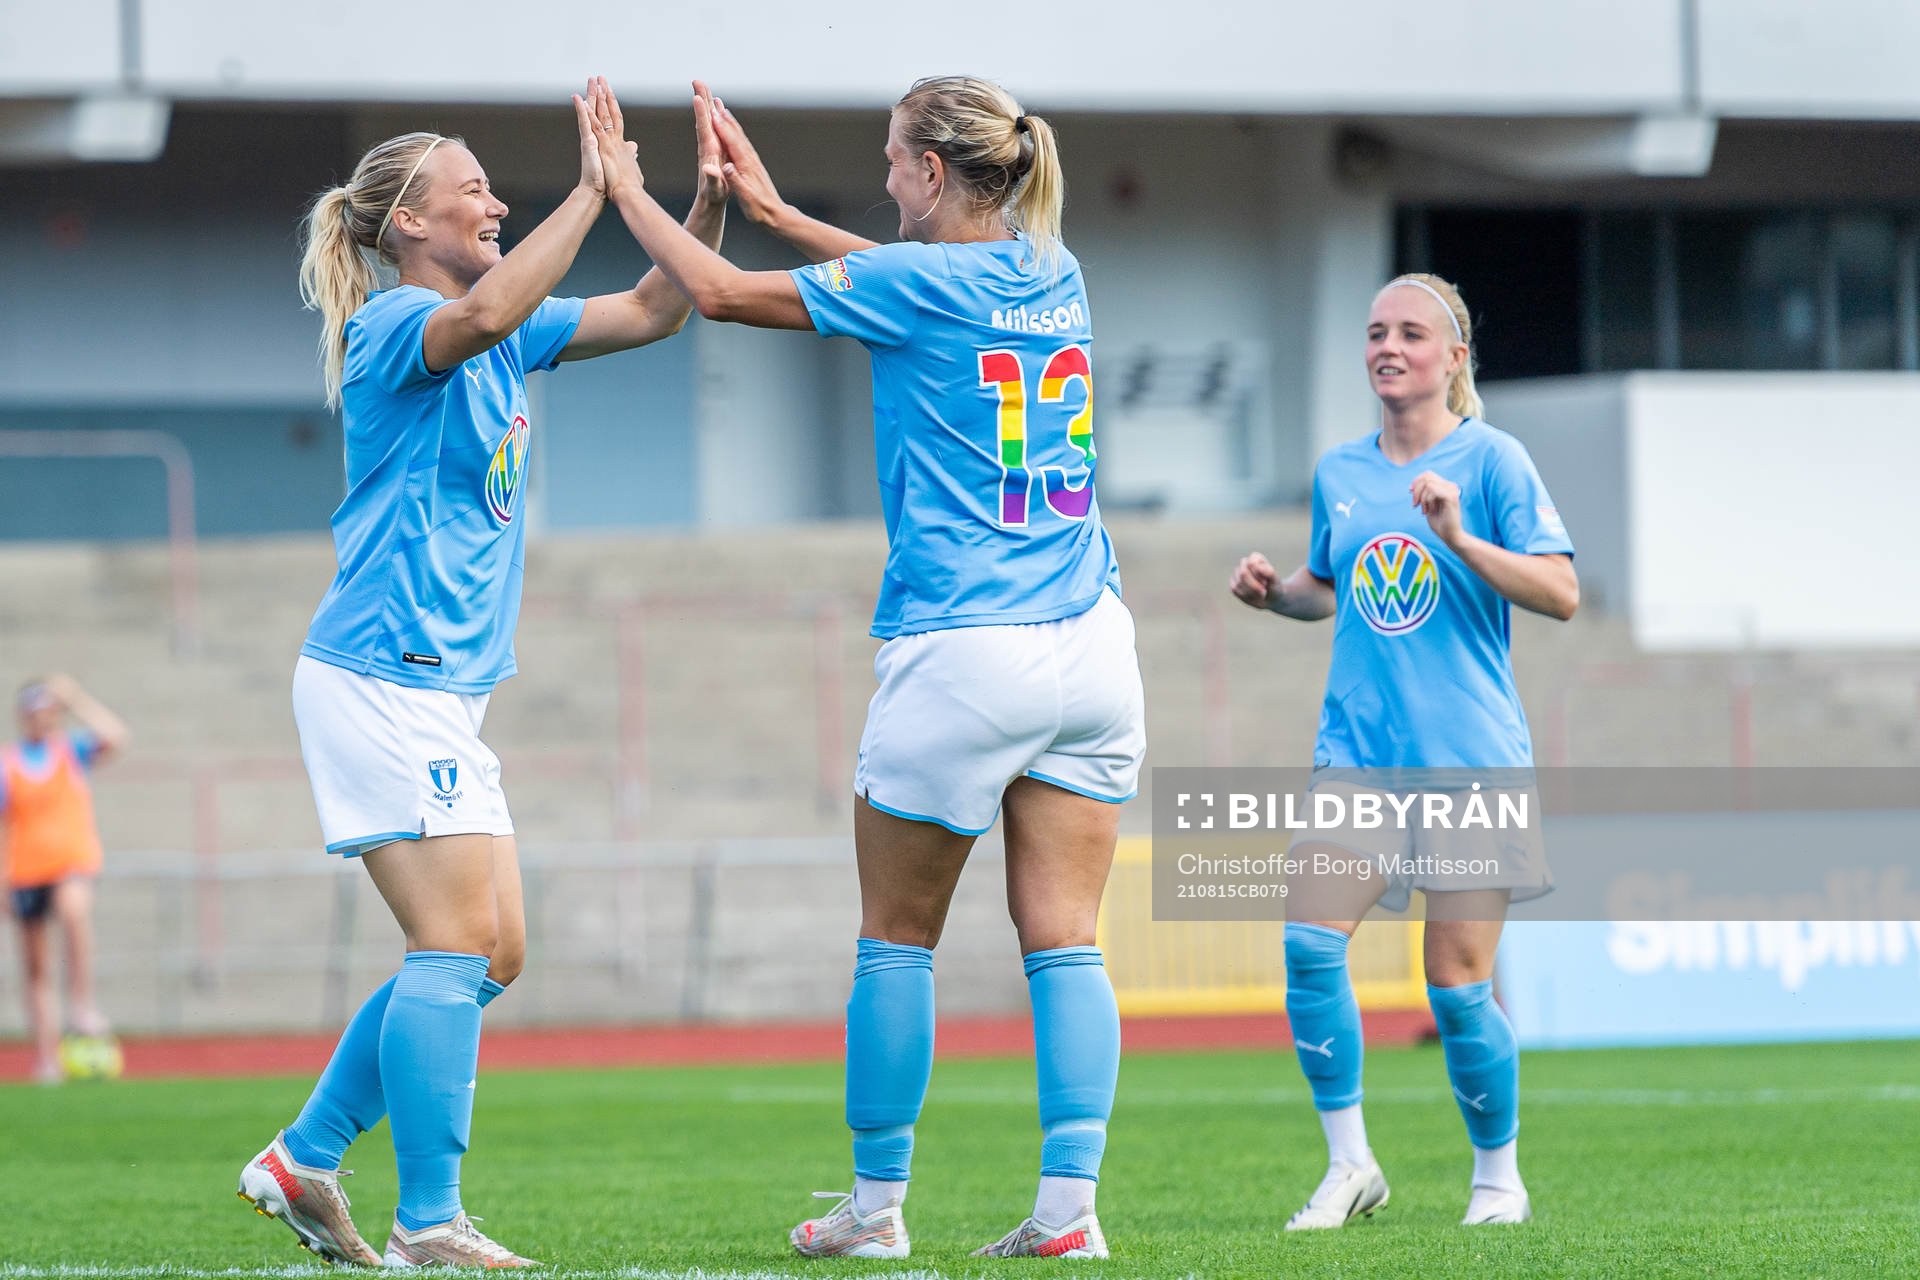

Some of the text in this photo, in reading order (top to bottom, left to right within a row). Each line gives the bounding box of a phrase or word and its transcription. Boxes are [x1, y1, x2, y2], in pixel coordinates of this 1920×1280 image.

[991, 302, 1086, 334] Nilsson
[977, 343, 1097, 528] 13
[1354, 534, 1439, 634] VW
